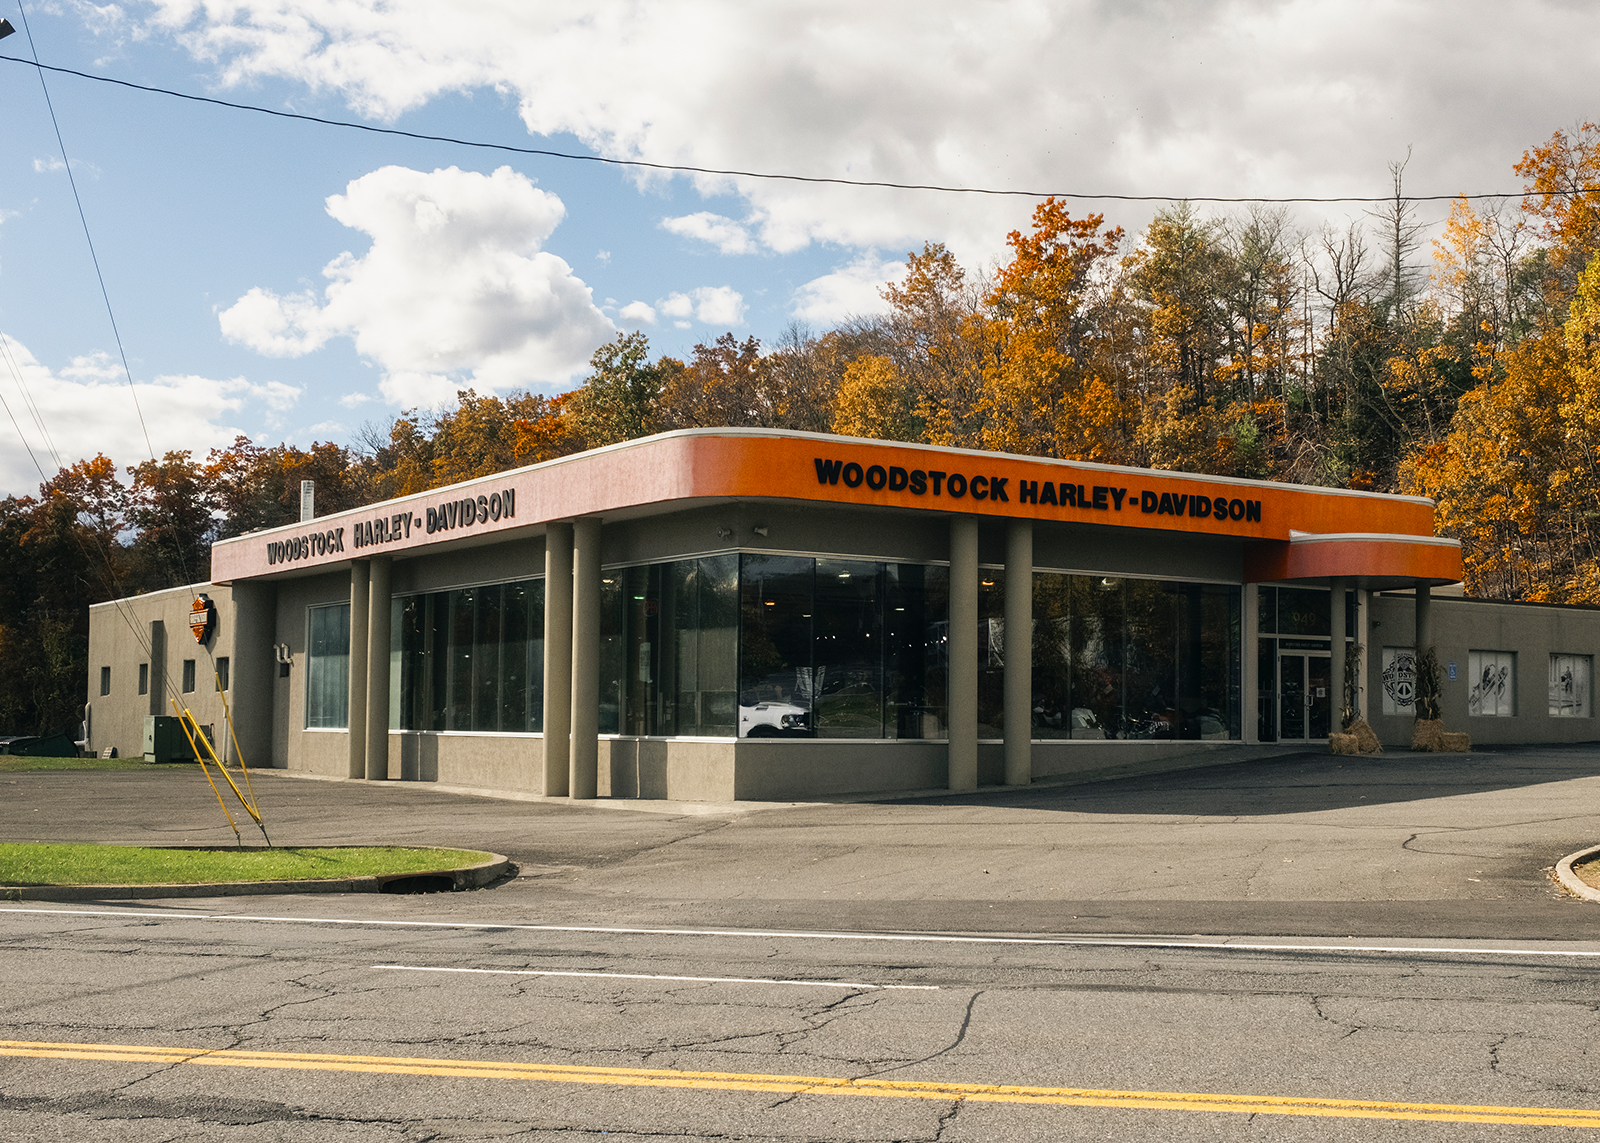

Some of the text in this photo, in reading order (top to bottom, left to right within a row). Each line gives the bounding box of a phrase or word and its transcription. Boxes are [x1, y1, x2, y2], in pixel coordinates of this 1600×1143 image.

[814, 458, 1261, 523] WOODSTOCK HARLEY-DAVIDSON
[267, 527, 344, 565] WOODSTOCK
[1292, 612, 1316, 626] 949
